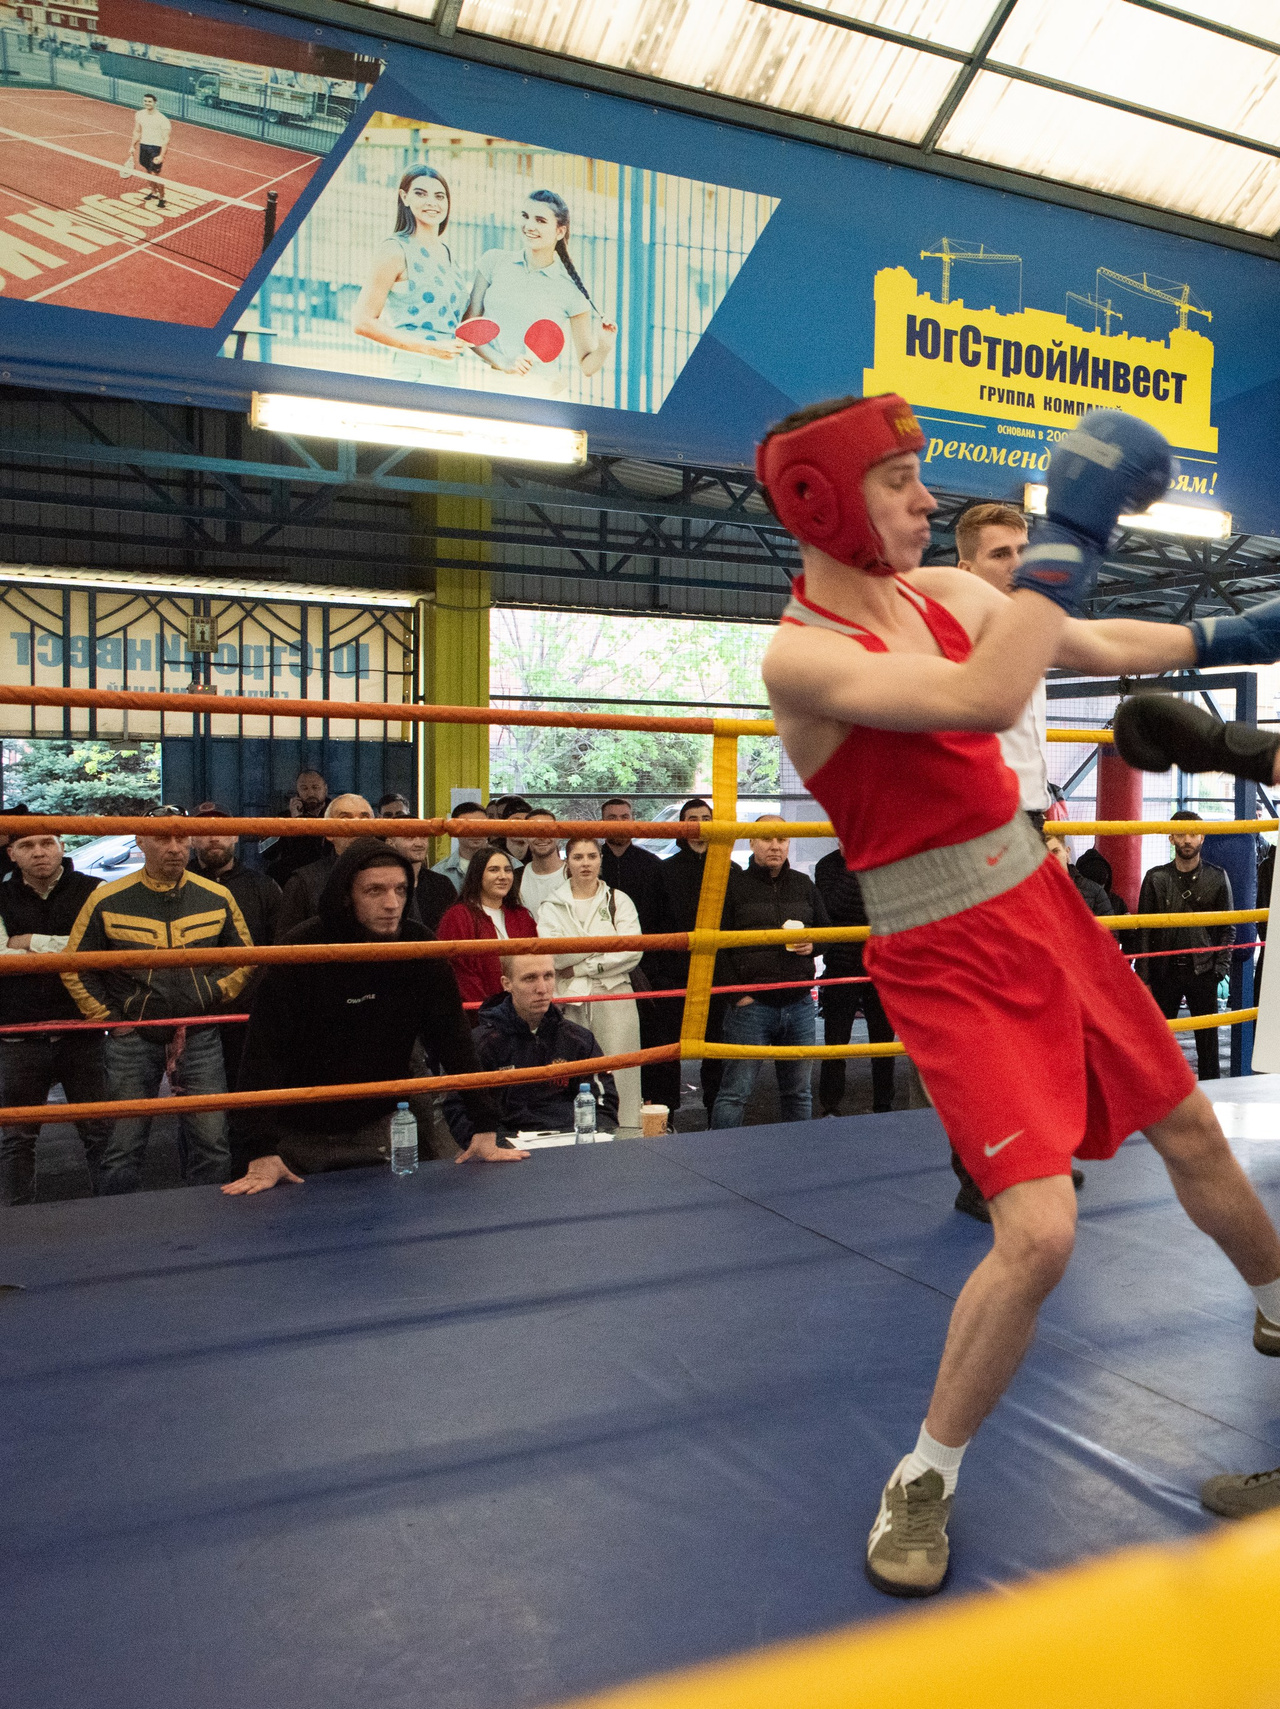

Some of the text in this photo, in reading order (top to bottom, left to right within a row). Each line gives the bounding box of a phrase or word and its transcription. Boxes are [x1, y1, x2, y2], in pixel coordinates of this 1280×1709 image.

[905, 313, 1188, 405] ЮгСтройИнвест
[979, 385, 1036, 409] ГРУППА
[997, 424, 1036, 439] ОСНОВАНА
[1038, 430, 1044, 440] В
[923, 437, 1052, 472] рекоменд
